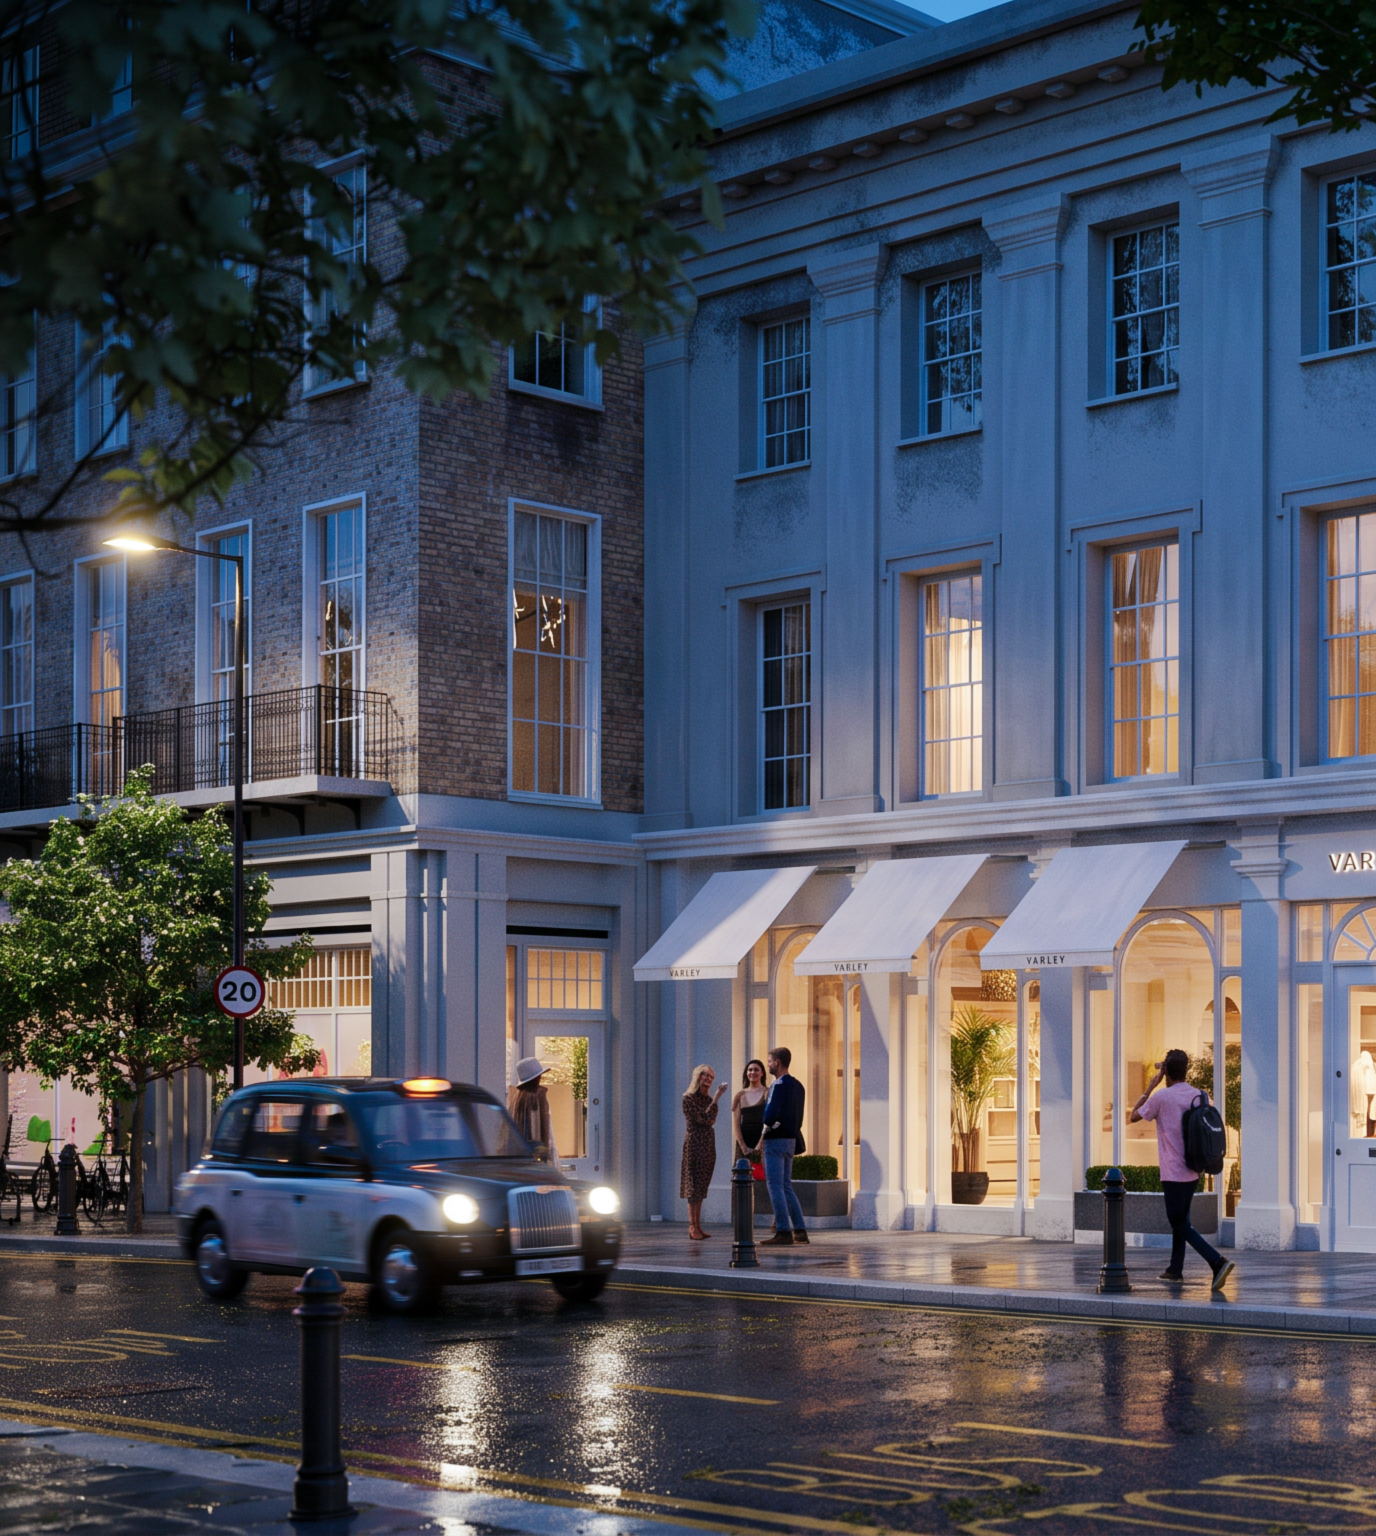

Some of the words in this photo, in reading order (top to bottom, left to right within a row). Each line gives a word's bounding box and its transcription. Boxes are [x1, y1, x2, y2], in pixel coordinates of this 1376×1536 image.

[1026, 955, 1065, 965] VARLEY
[669, 968, 700, 977] VARLEY
[222, 981, 257, 1002] 20
